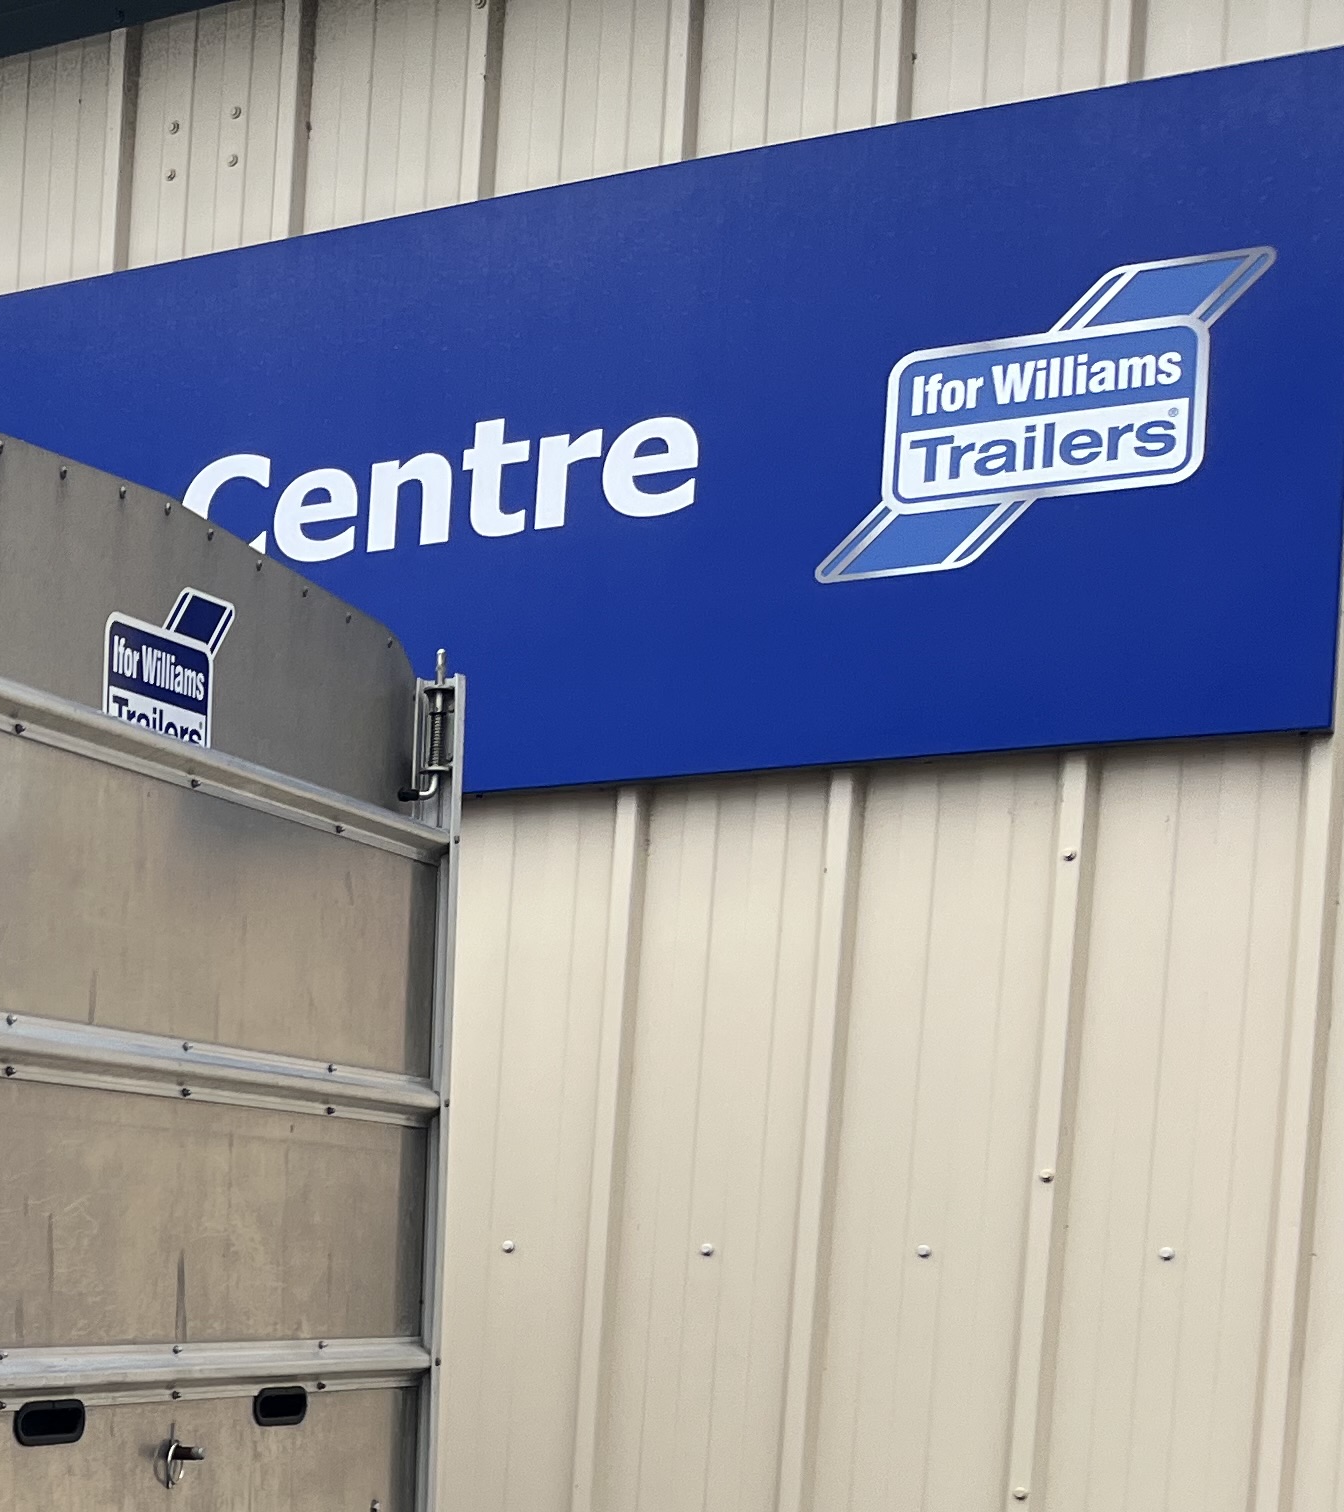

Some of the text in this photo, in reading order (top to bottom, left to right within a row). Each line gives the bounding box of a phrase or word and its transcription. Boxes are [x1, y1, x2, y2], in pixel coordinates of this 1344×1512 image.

[910, 351, 1182, 416] Ifor Williams
[909, 419, 1177, 483] Trailers
[182, 416, 700, 562] Centre
[112, 635, 205, 701] Ifor Williams
